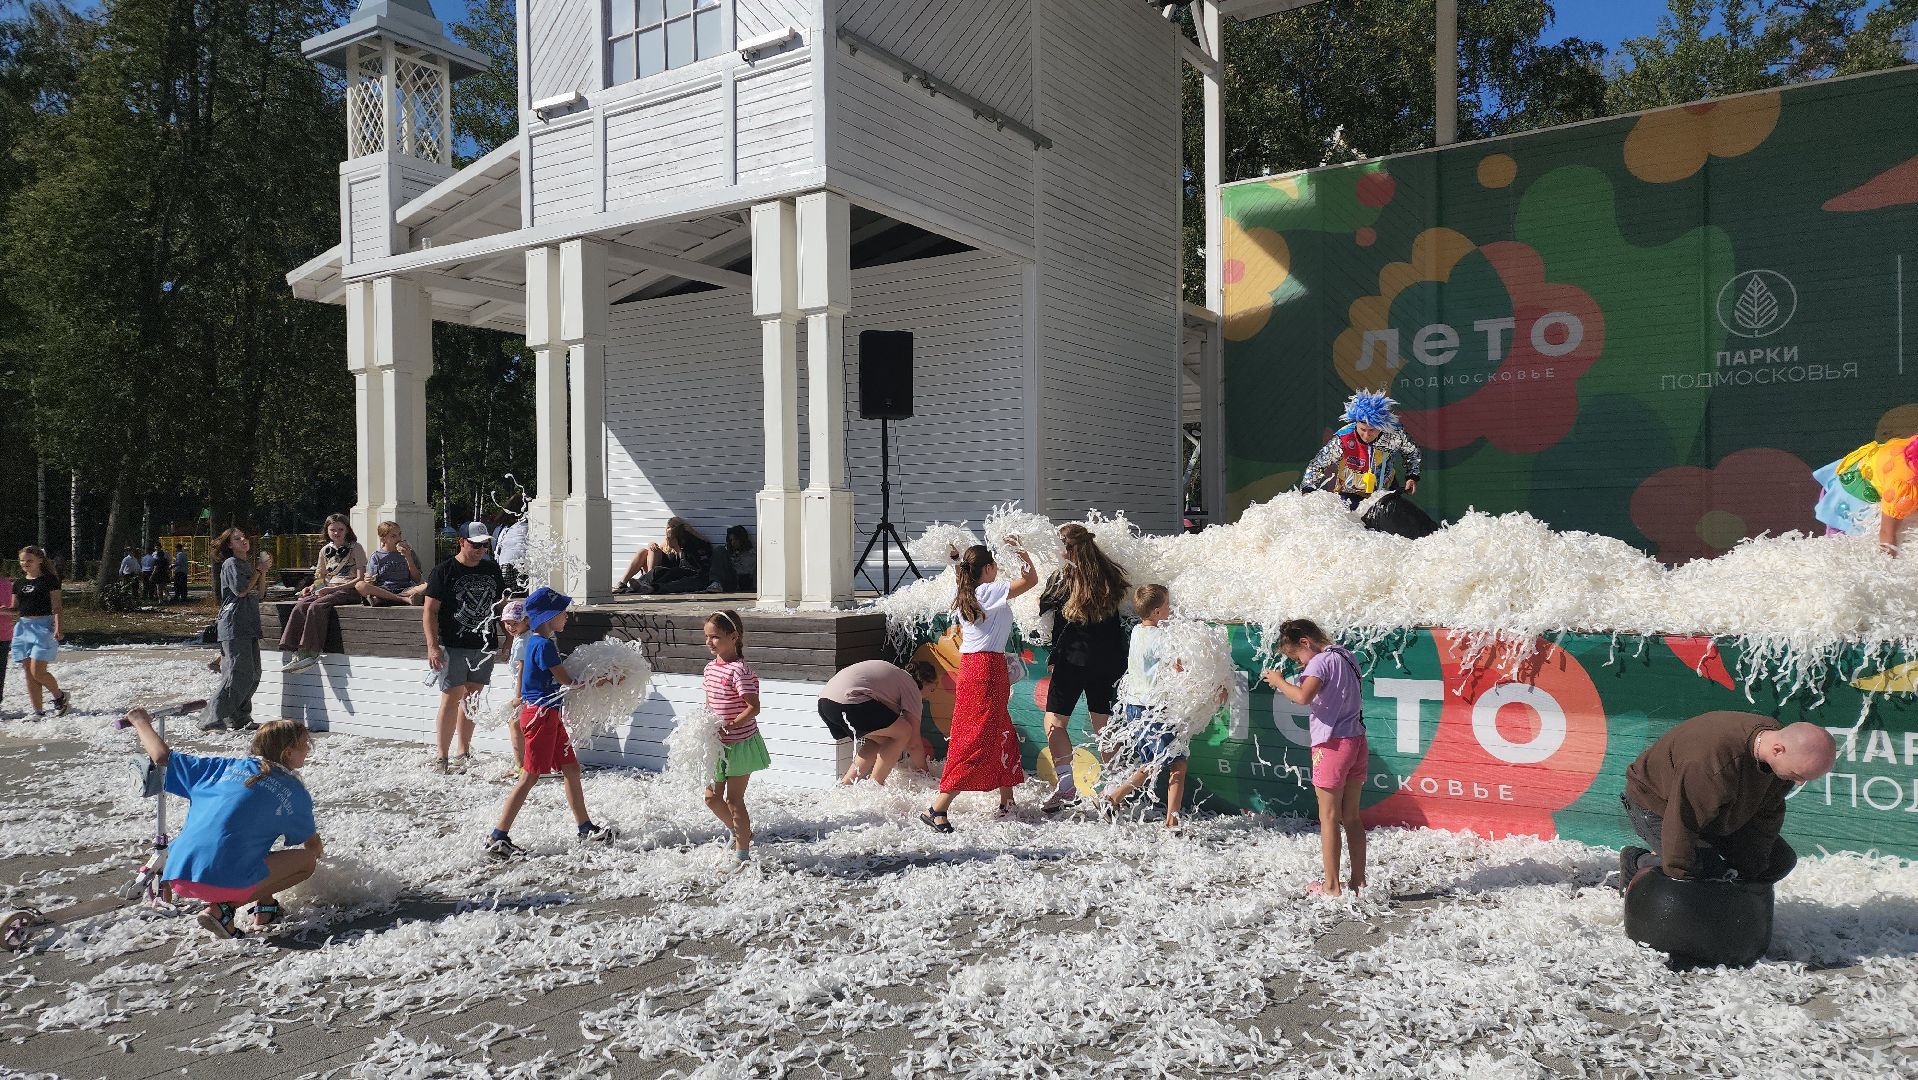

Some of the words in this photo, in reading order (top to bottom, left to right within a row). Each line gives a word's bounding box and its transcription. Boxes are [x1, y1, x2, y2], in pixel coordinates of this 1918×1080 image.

[1716, 345, 1799, 367] ПАРКИ
[1400, 367, 1555, 389] ПОДМОСКОВЬЕ
[1660, 361, 1859, 391] ПОДМОСКОВЬЯ
[1218, 758, 1232, 774] В
[1251, 761, 1514, 801] ПОДСКОВЬЕ
